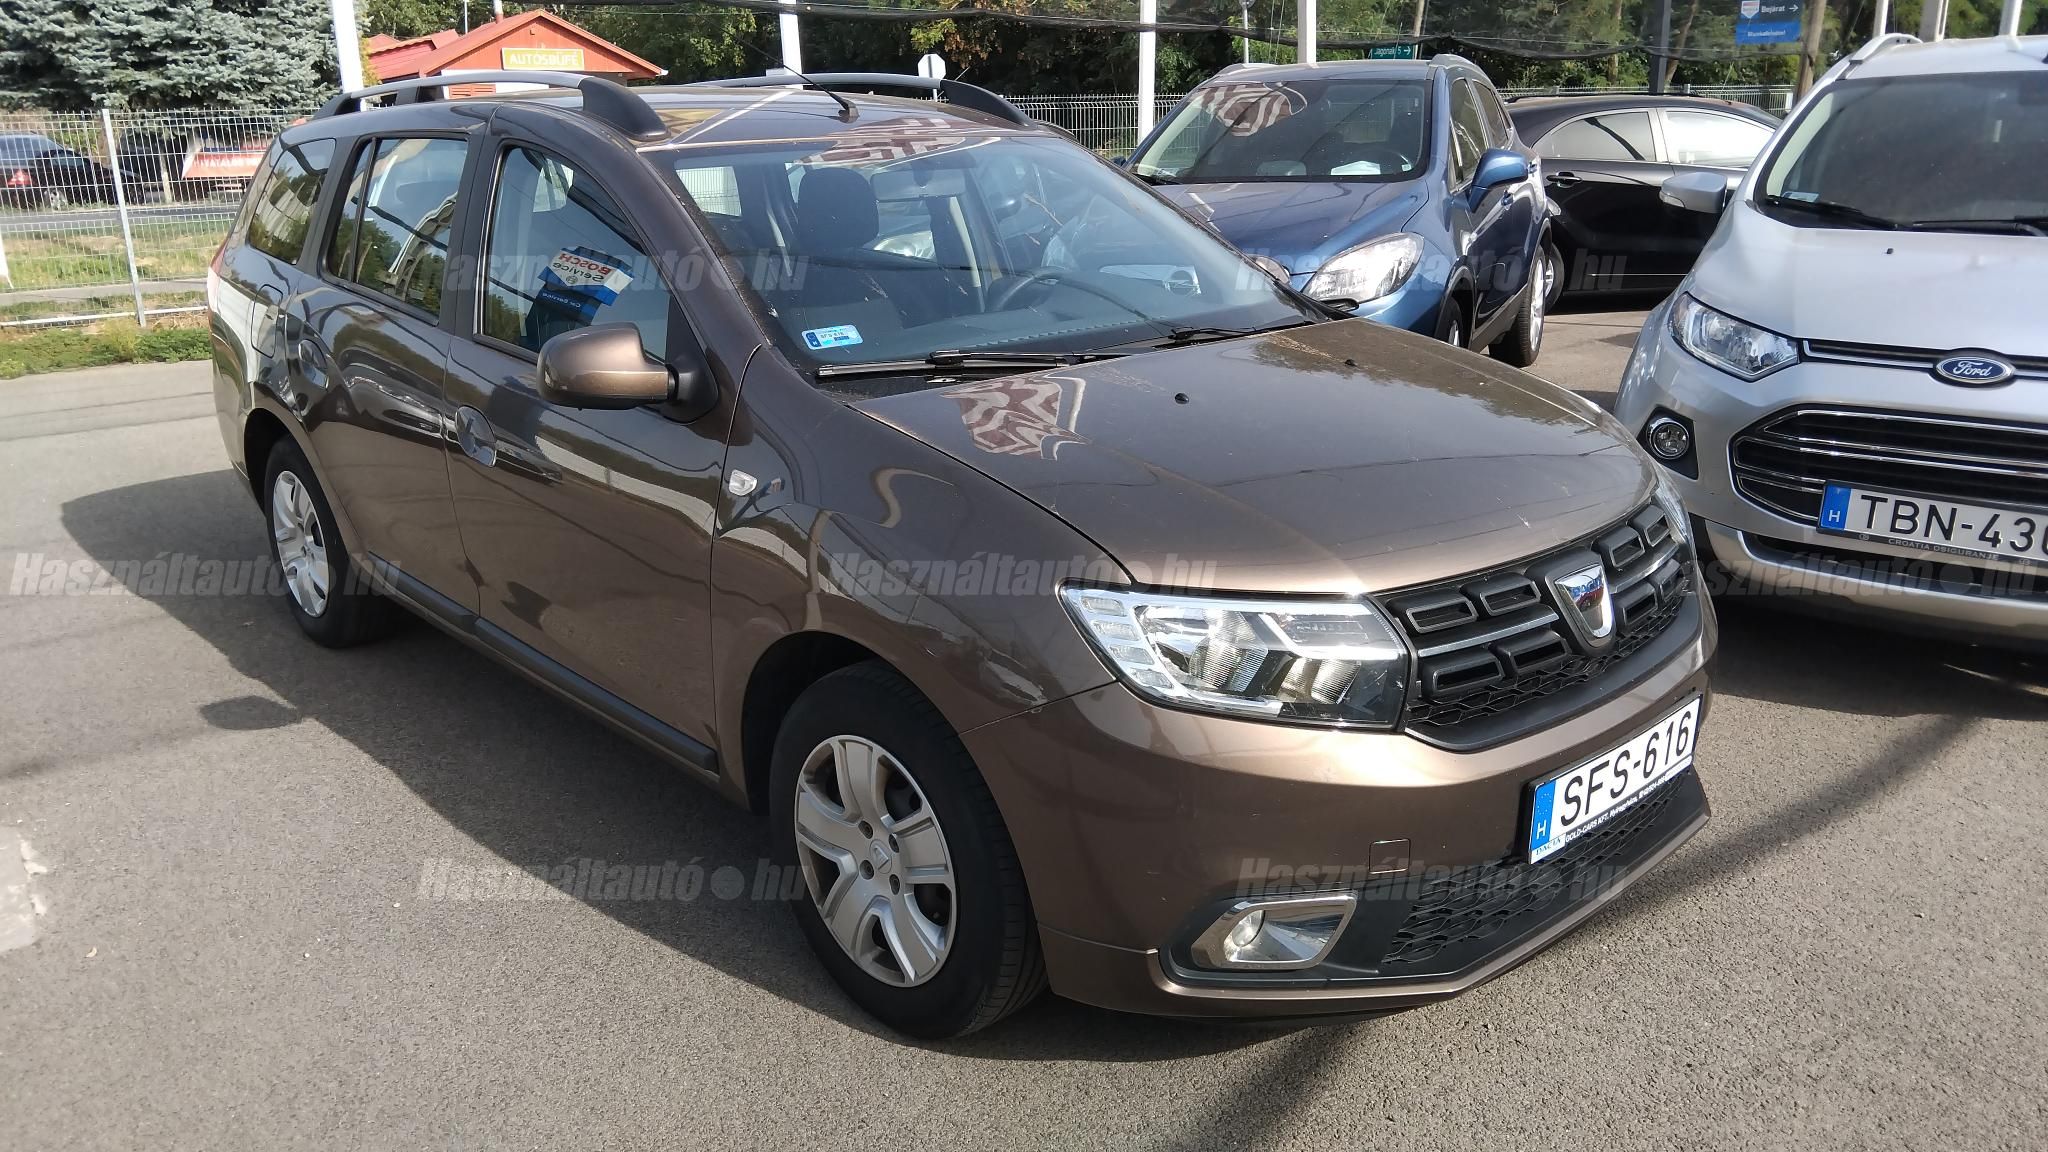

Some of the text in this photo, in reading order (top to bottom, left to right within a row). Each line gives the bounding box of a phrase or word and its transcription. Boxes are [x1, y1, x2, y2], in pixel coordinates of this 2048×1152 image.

[1953, 360, 1993, 377] Ford
[1828, 509, 1840, 523] H
[1860, 494, 2048, 557] TBN-43
[1888, 538, 2000, 562] CROATIA OSIGURANJE
[1560, 710, 1692, 827] SFS-616
[1536, 819, 1547, 840] H
